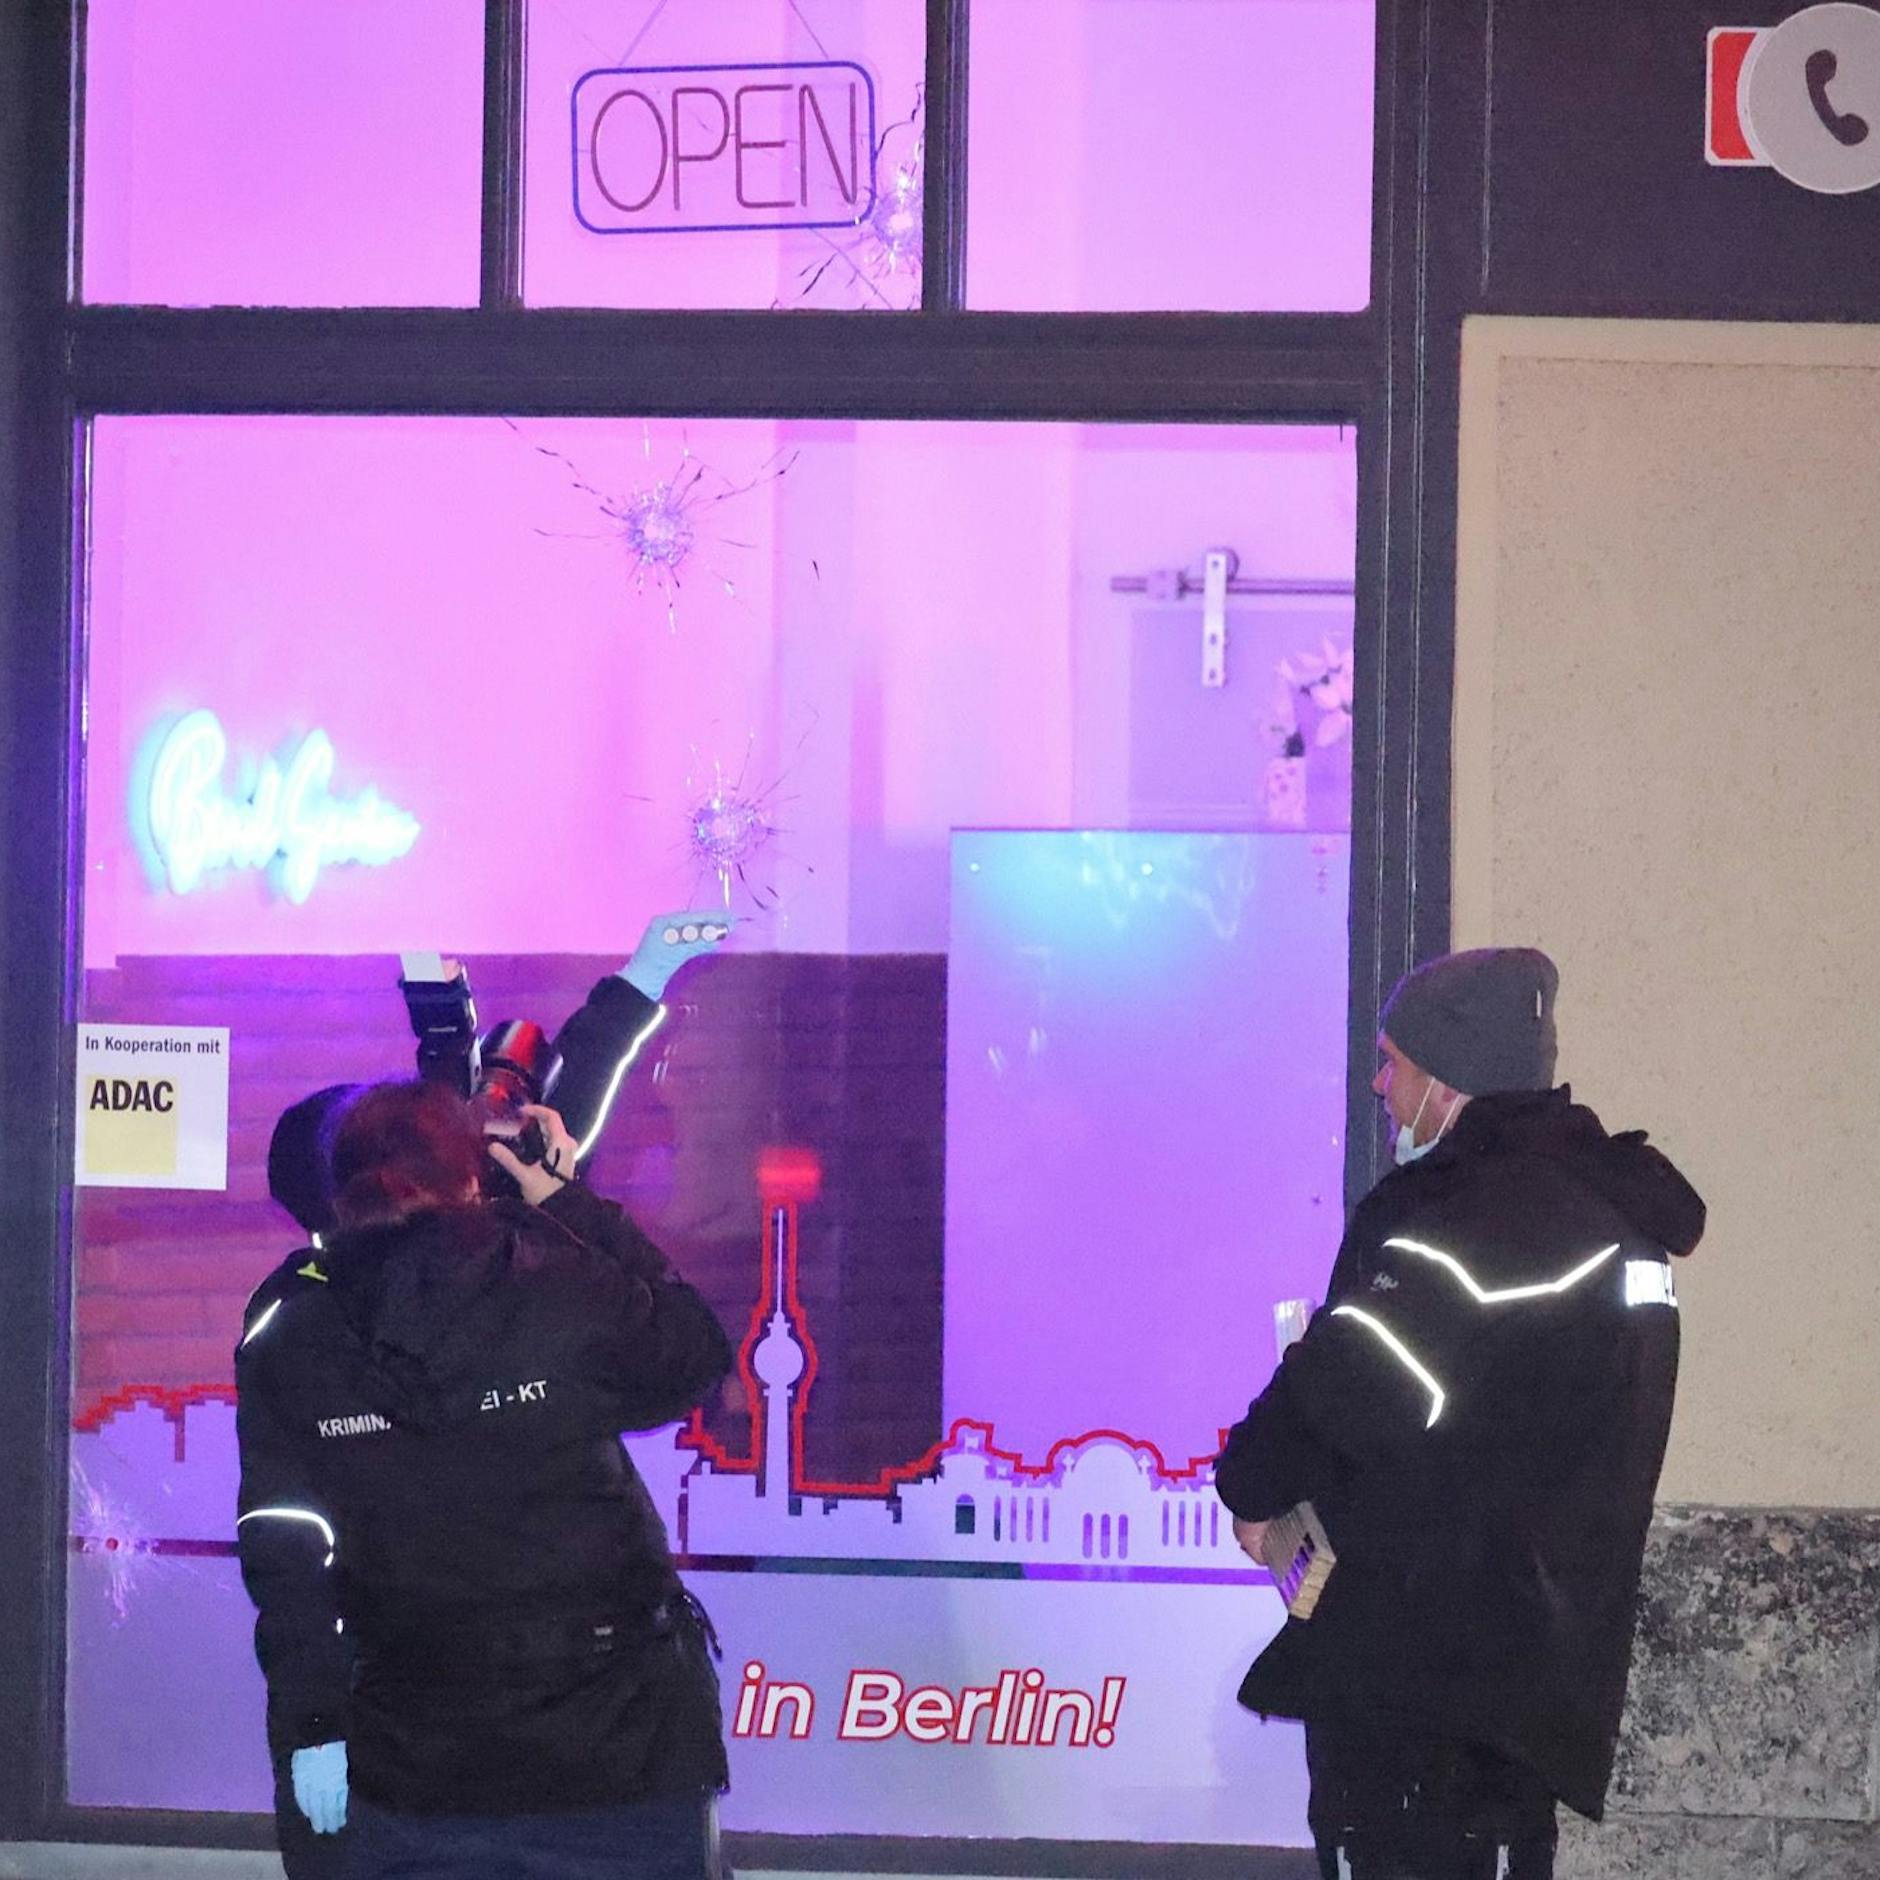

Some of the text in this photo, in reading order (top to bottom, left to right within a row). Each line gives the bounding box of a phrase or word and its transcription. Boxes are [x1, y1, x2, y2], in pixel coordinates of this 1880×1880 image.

[590, 82, 857, 212] OPEN
[85, 1036, 220, 1054] In Kooperation mit
[89, 1079, 173, 1112] ADAC
[518, 1380, 547, 1402] KT
[732, 1660, 1127, 1748] in Berlin!
